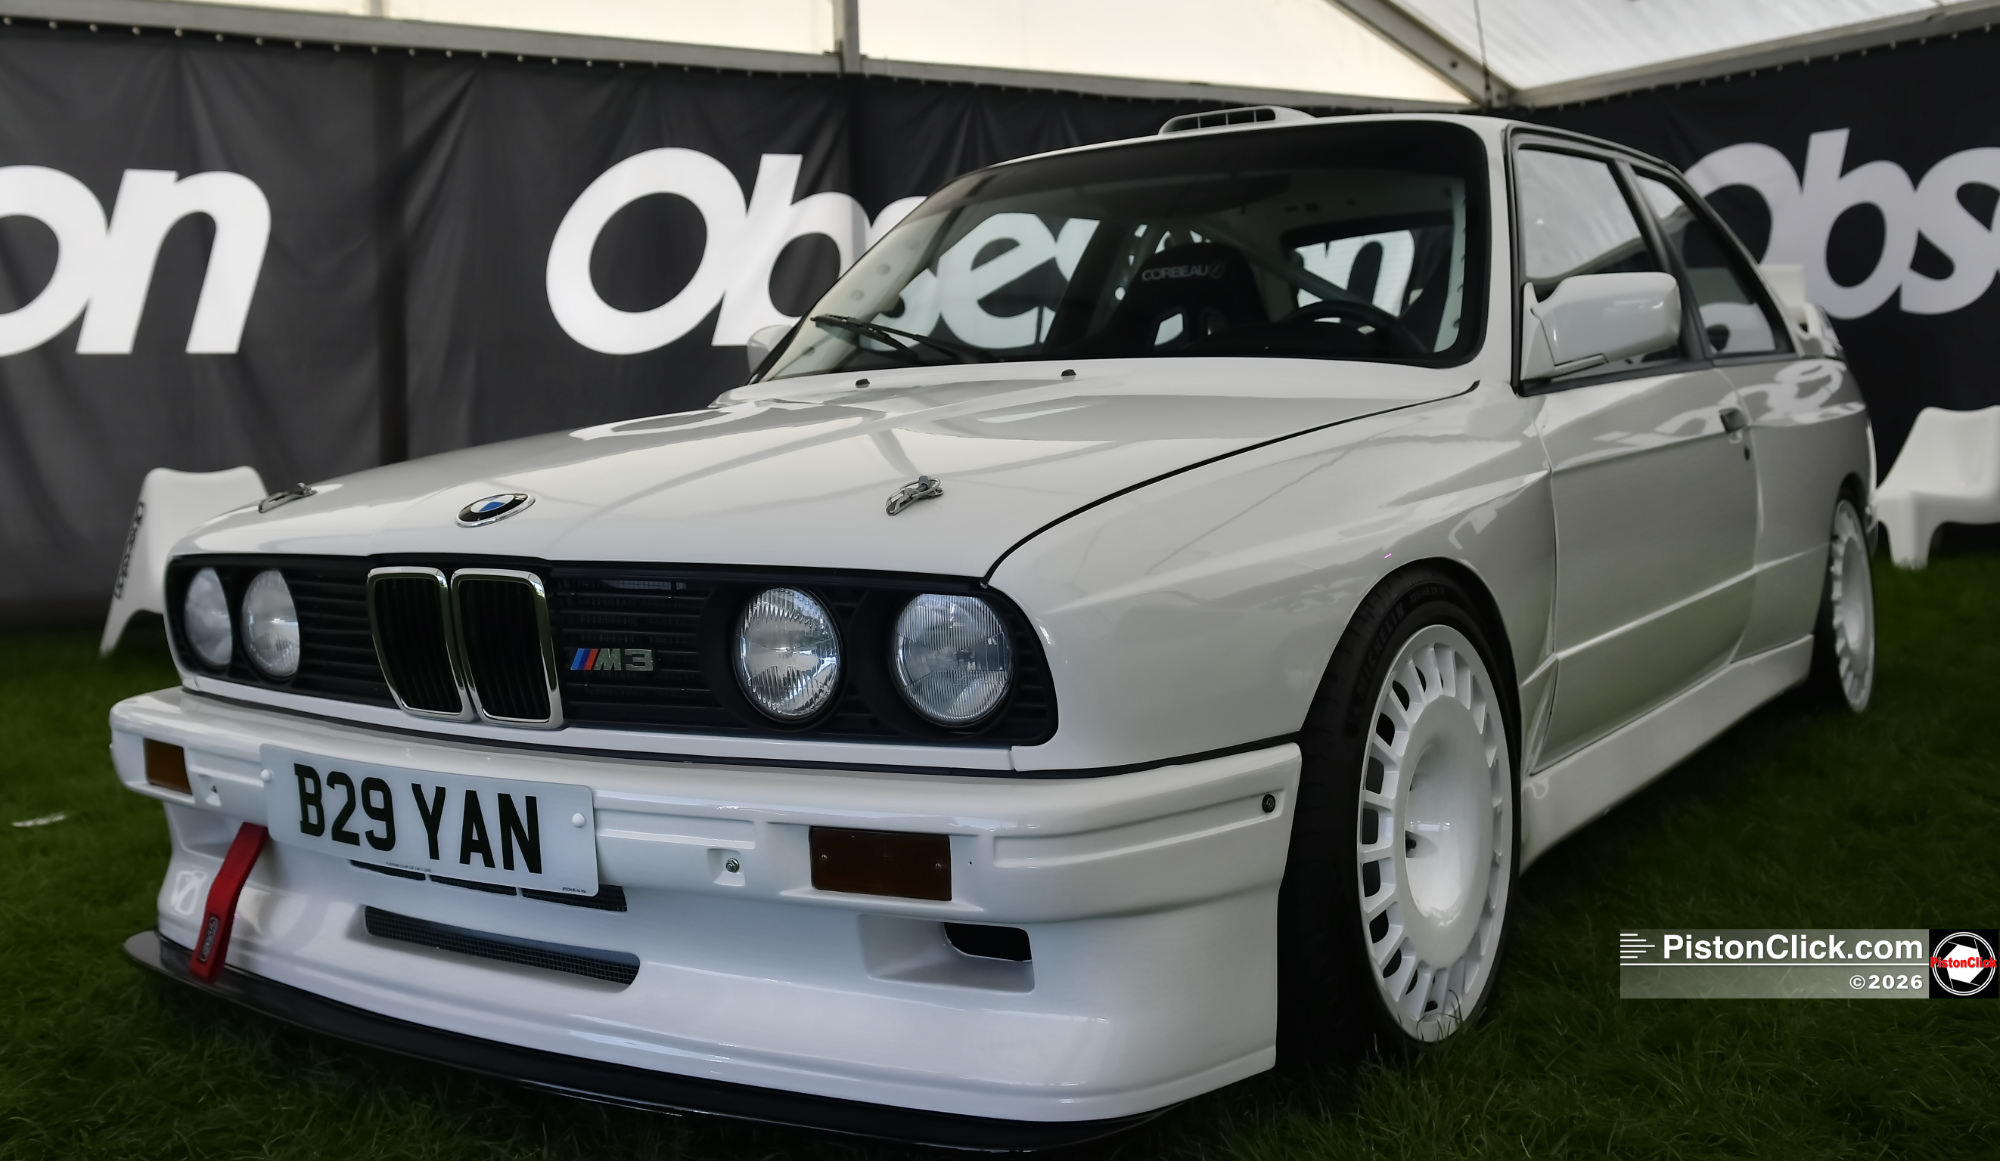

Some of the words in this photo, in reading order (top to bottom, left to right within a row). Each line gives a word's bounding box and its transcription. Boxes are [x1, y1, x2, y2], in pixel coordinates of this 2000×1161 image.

[1141, 263, 1209, 282] CORBEAU
[593, 648, 654, 671] M3
[1355, 601, 1406, 698] MICHELIN
[293, 762, 396, 852] B29
[411, 782, 543, 875] YAN
